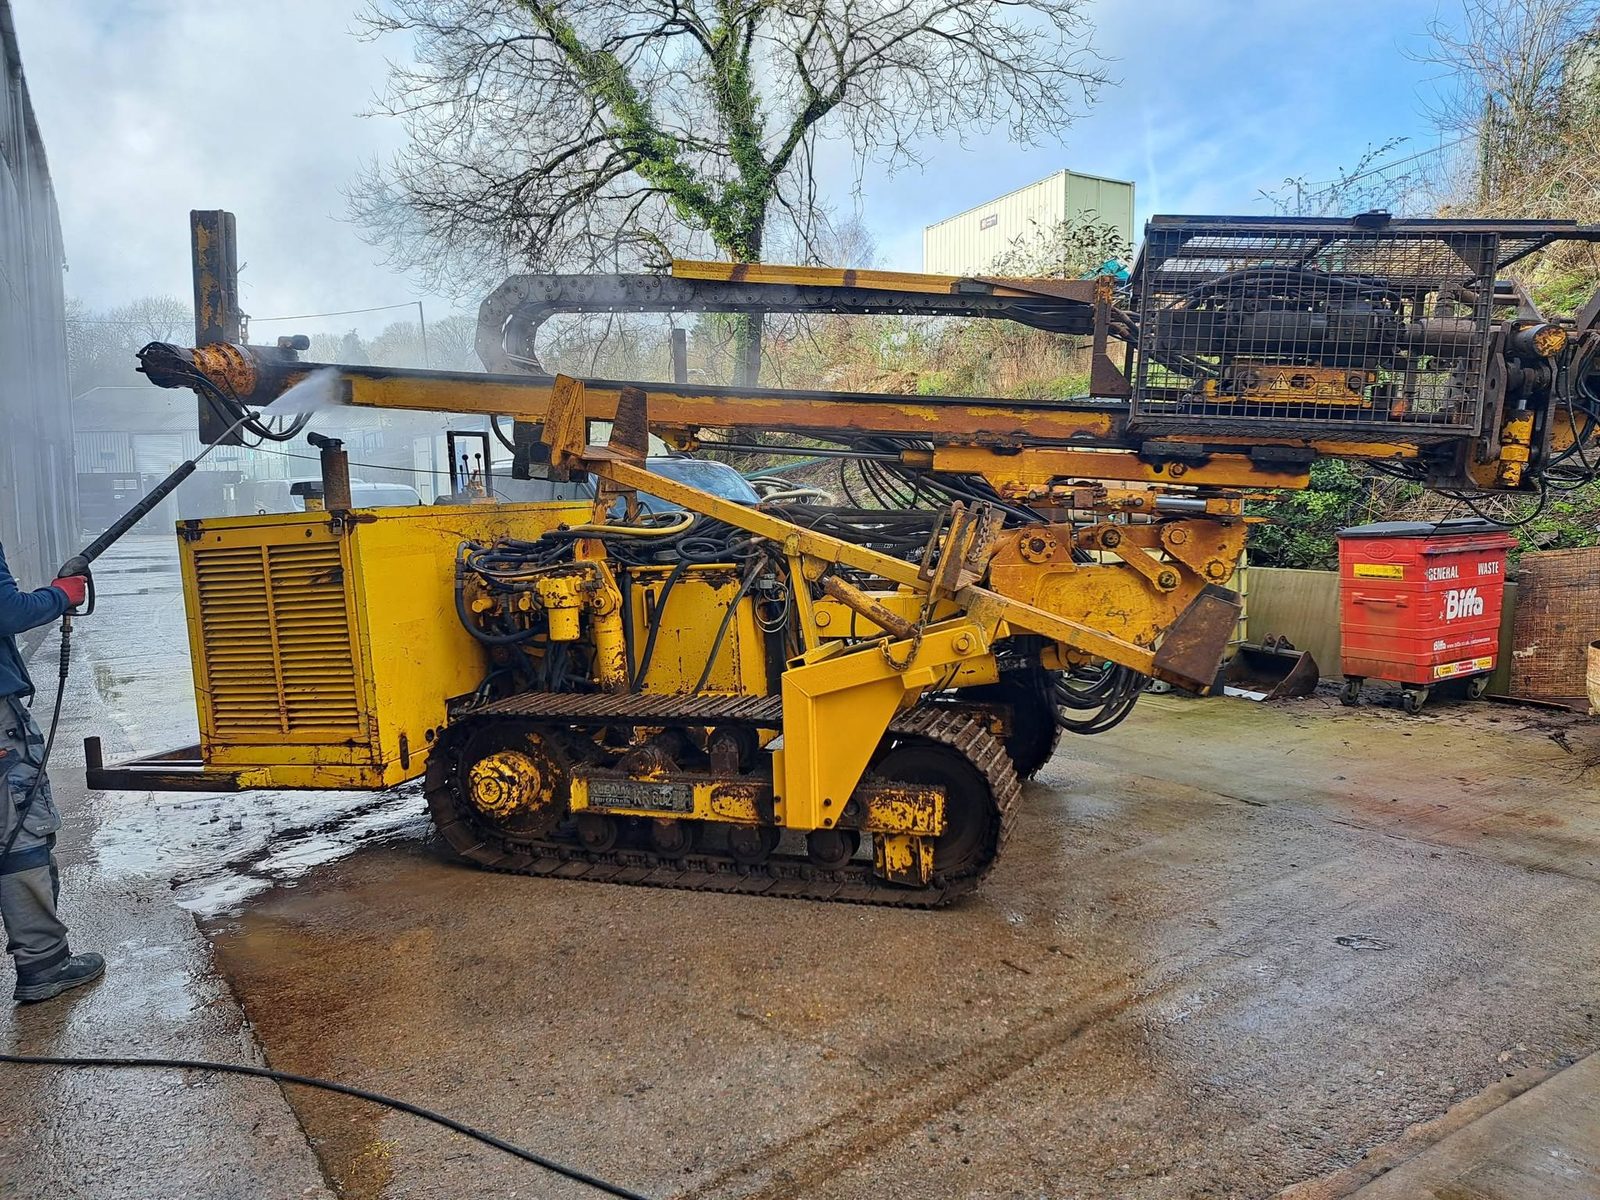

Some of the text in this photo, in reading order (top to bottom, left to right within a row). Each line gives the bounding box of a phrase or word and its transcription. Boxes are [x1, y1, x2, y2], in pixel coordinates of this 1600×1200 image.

[1428, 561, 1499, 581] GENERAL WASTE
[1446, 587, 1484, 620] Biffa
